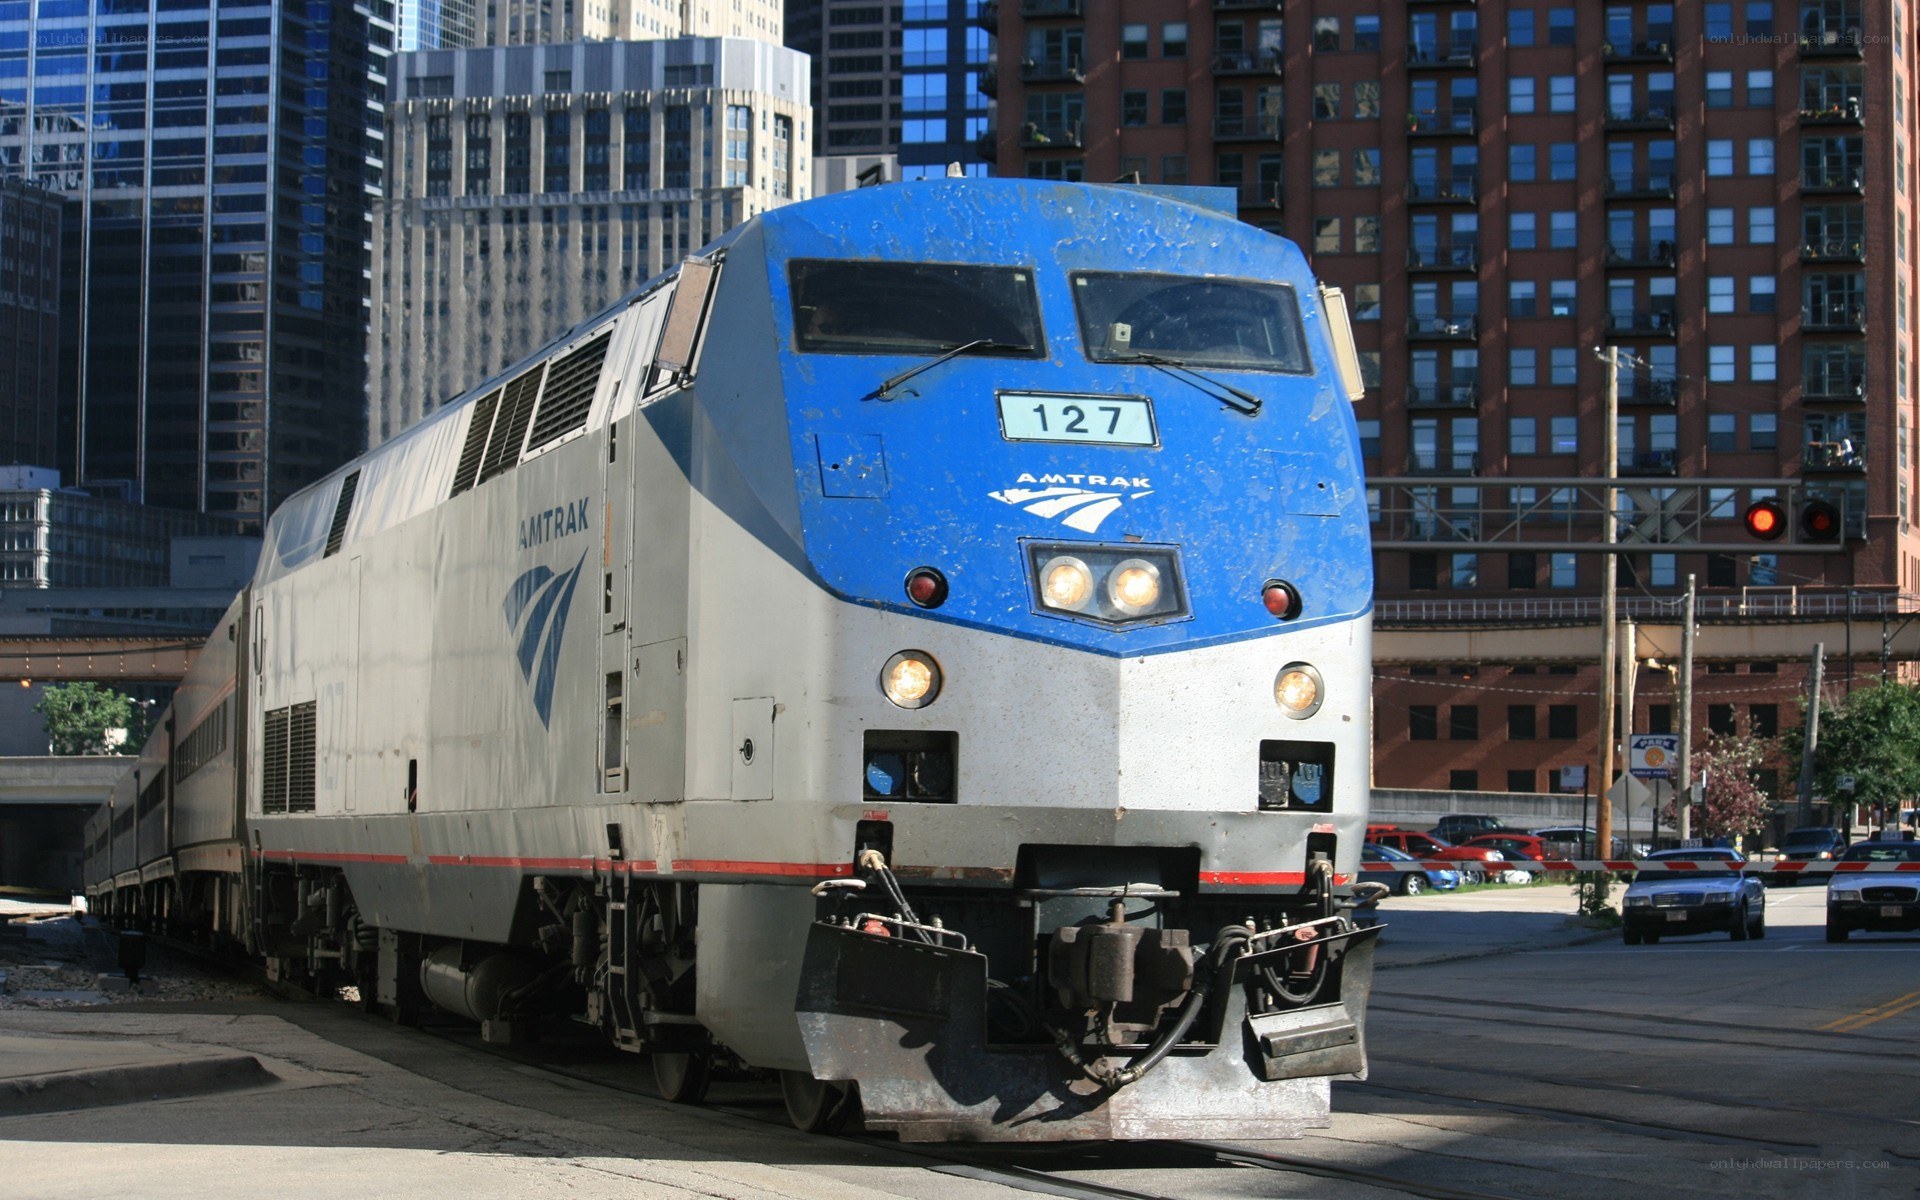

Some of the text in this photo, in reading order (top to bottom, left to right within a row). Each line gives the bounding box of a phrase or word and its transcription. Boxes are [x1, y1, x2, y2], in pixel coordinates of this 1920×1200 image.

[1032, 403, 1122, 435] 127
[1016, 473, 1151, 488] AMTRAK
[518, 496, 589, 551] AMTRAK
[1639, 739, 1671, 748] PARK
